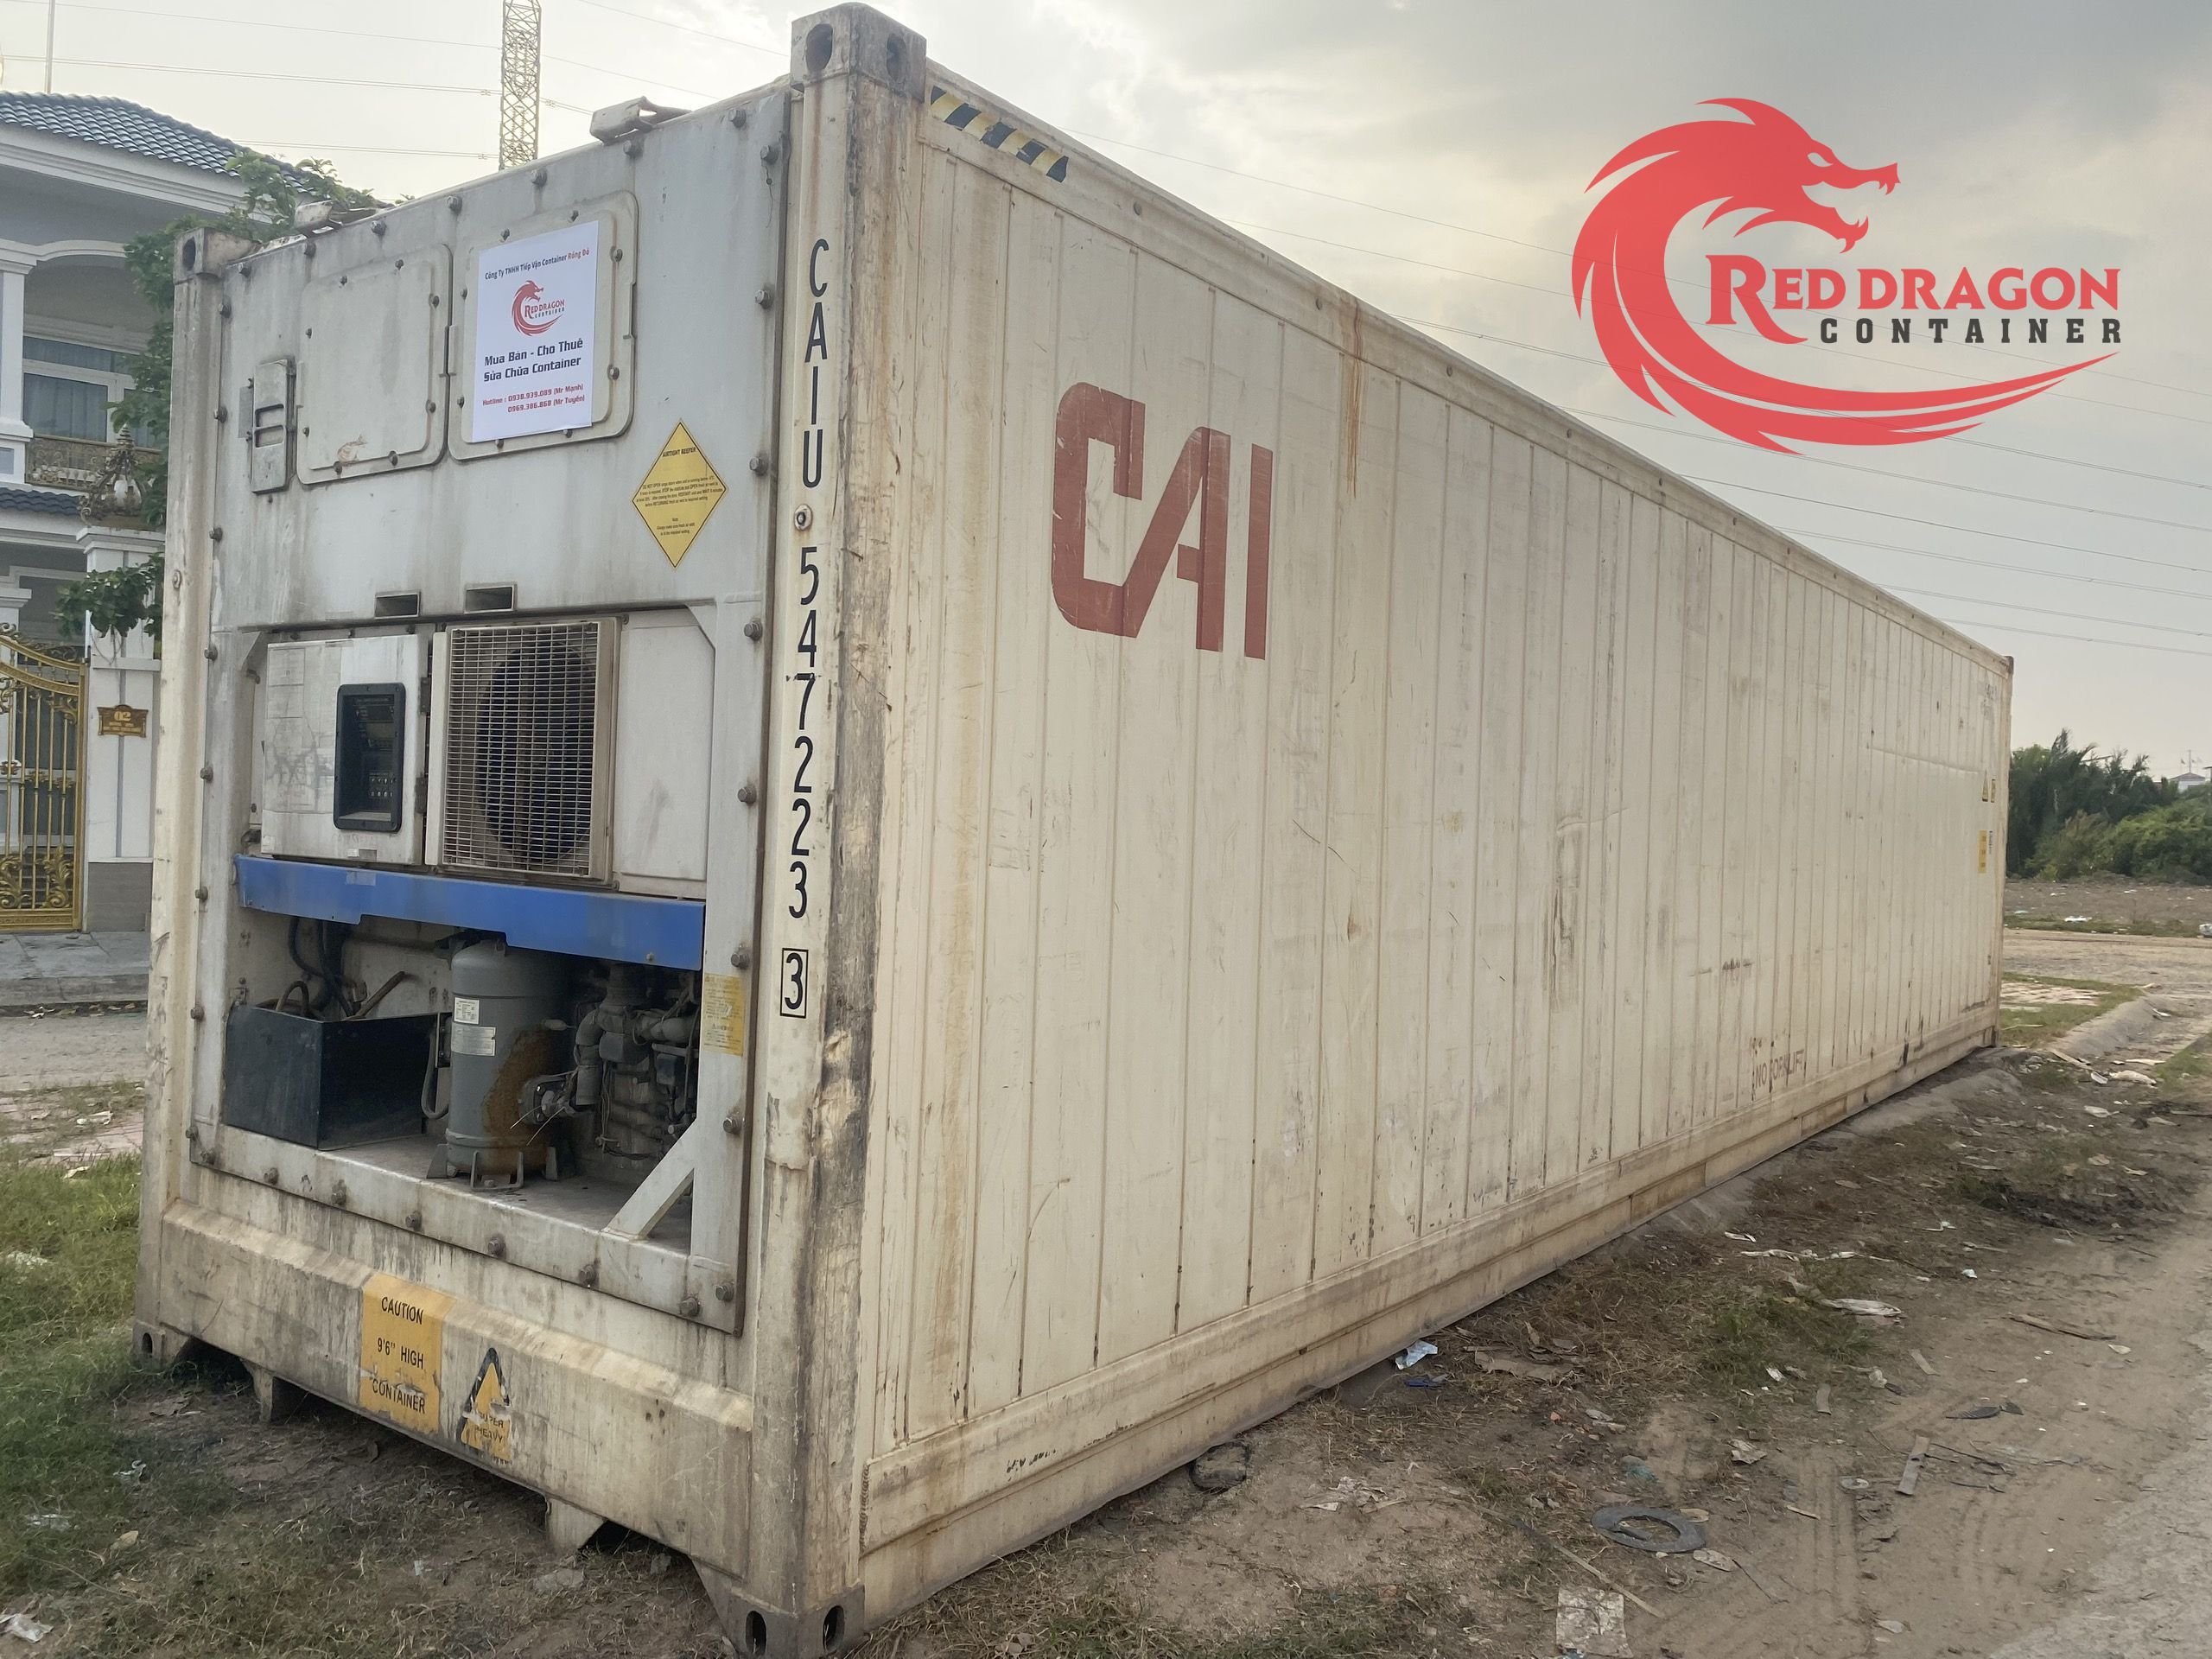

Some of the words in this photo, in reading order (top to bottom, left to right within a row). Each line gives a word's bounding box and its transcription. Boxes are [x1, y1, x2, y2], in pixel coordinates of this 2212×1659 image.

[505, 265, 519, 274] TNHH
[542, 255, 567, 266] Container
[524, 304, 538, 320] RED
[539, 299, 565, 312] DRAGON
[485, 355, 505, 366] Mua
[537, 345, 556, 356] Cho
[558, 338, 583, 352] Thuê
[532, 357, 581, 373] Container
[802, 238, 830, 489] CAIU
[1051, 382, 1273, 660] CAI
[784, 951, 804, 1011] 3
[381, 1296, 424, 1325] CAUTION
[400, 1346, 424, 1370] HIGH
[372, 1379, 426, 1414] CONTAINER
